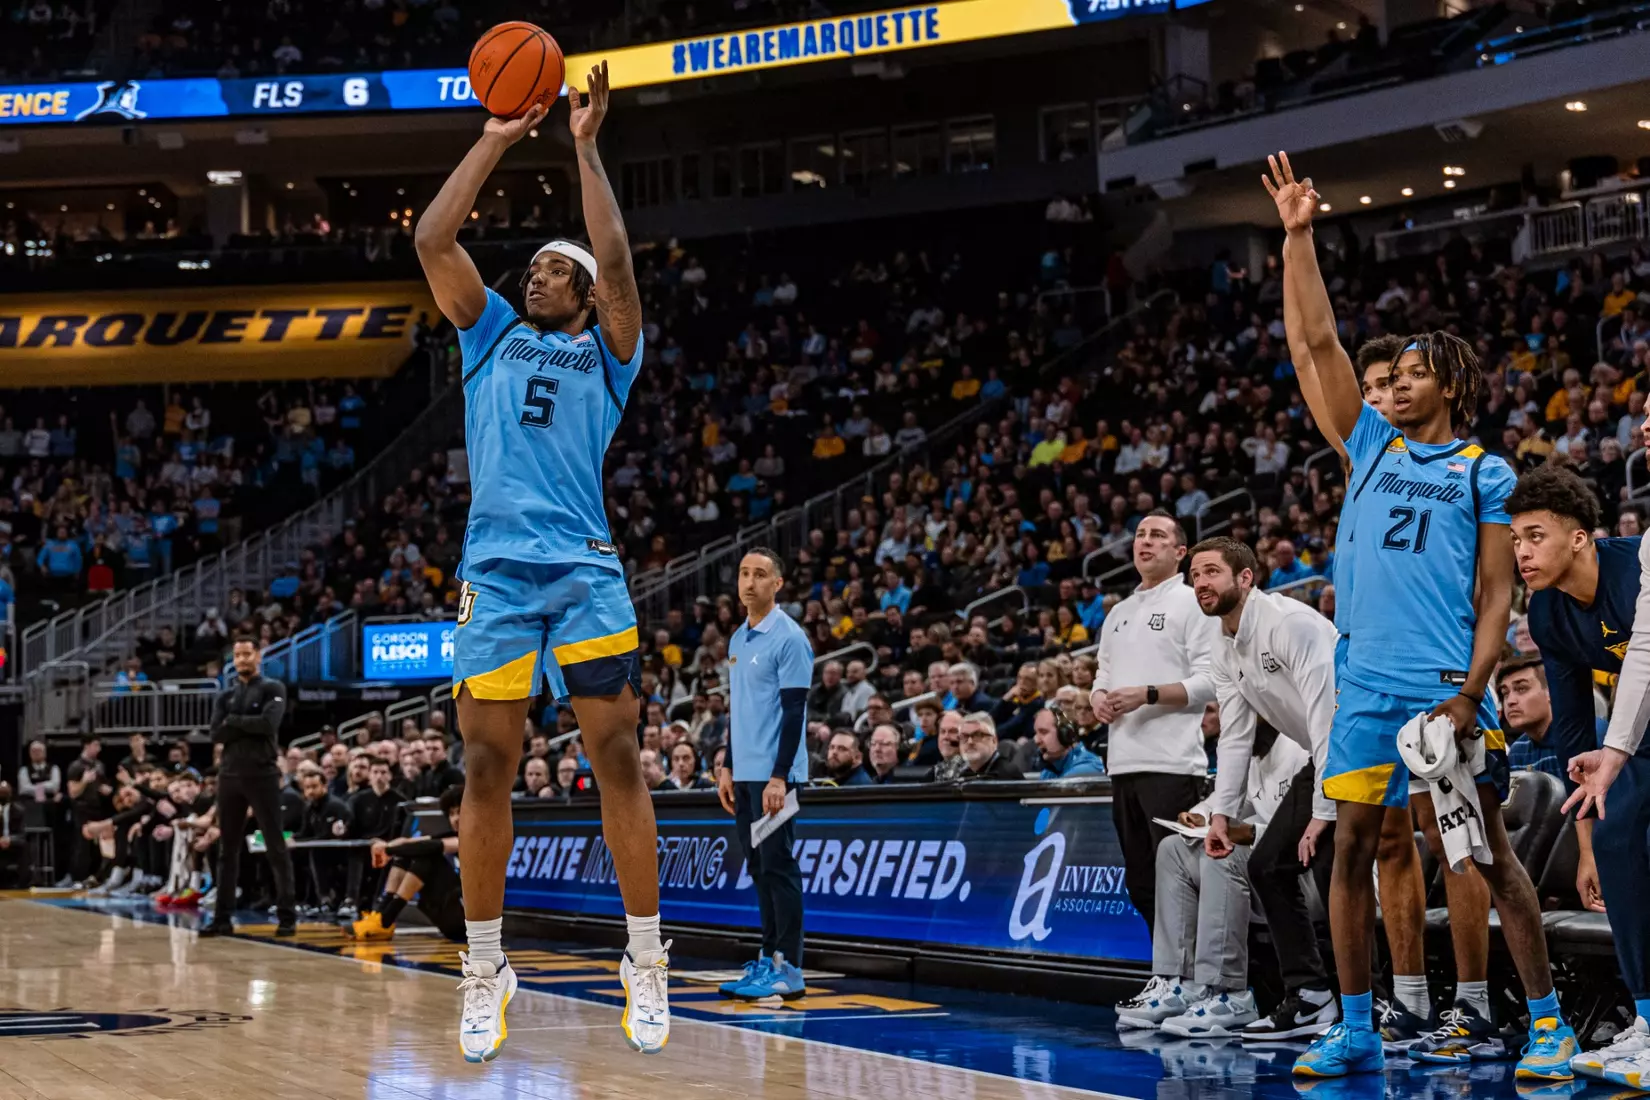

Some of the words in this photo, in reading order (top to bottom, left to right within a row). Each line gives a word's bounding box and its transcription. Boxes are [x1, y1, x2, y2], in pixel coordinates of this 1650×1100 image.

[672, 7, 940, 74] #WEAREMARQUETTE
[252, 81, 304, 108] FLS
[343, 77, 369, 106] 6
[437, 75, 478, 101] TO
[0, 91, 70, 118] ENCE
[500, 337, 598, 374] Marquette
[519, 375, 559, 428] 5
[1373, 471, 1465, 504] Marquette
[1382, 505, 1432, 554] 21
[372, 632, 428, 645] GORDON
[372, 644, 428, 661] FLESCH
[505, 836, 588, 881] ESTATE
[581, 835, 728, 890] INTING.
[735, 839, 971, 902] ERSIFIED.
[1059, 866, 1129, 894] INVEST
[1054, 898, 1125, 916] ASSOCIATED
